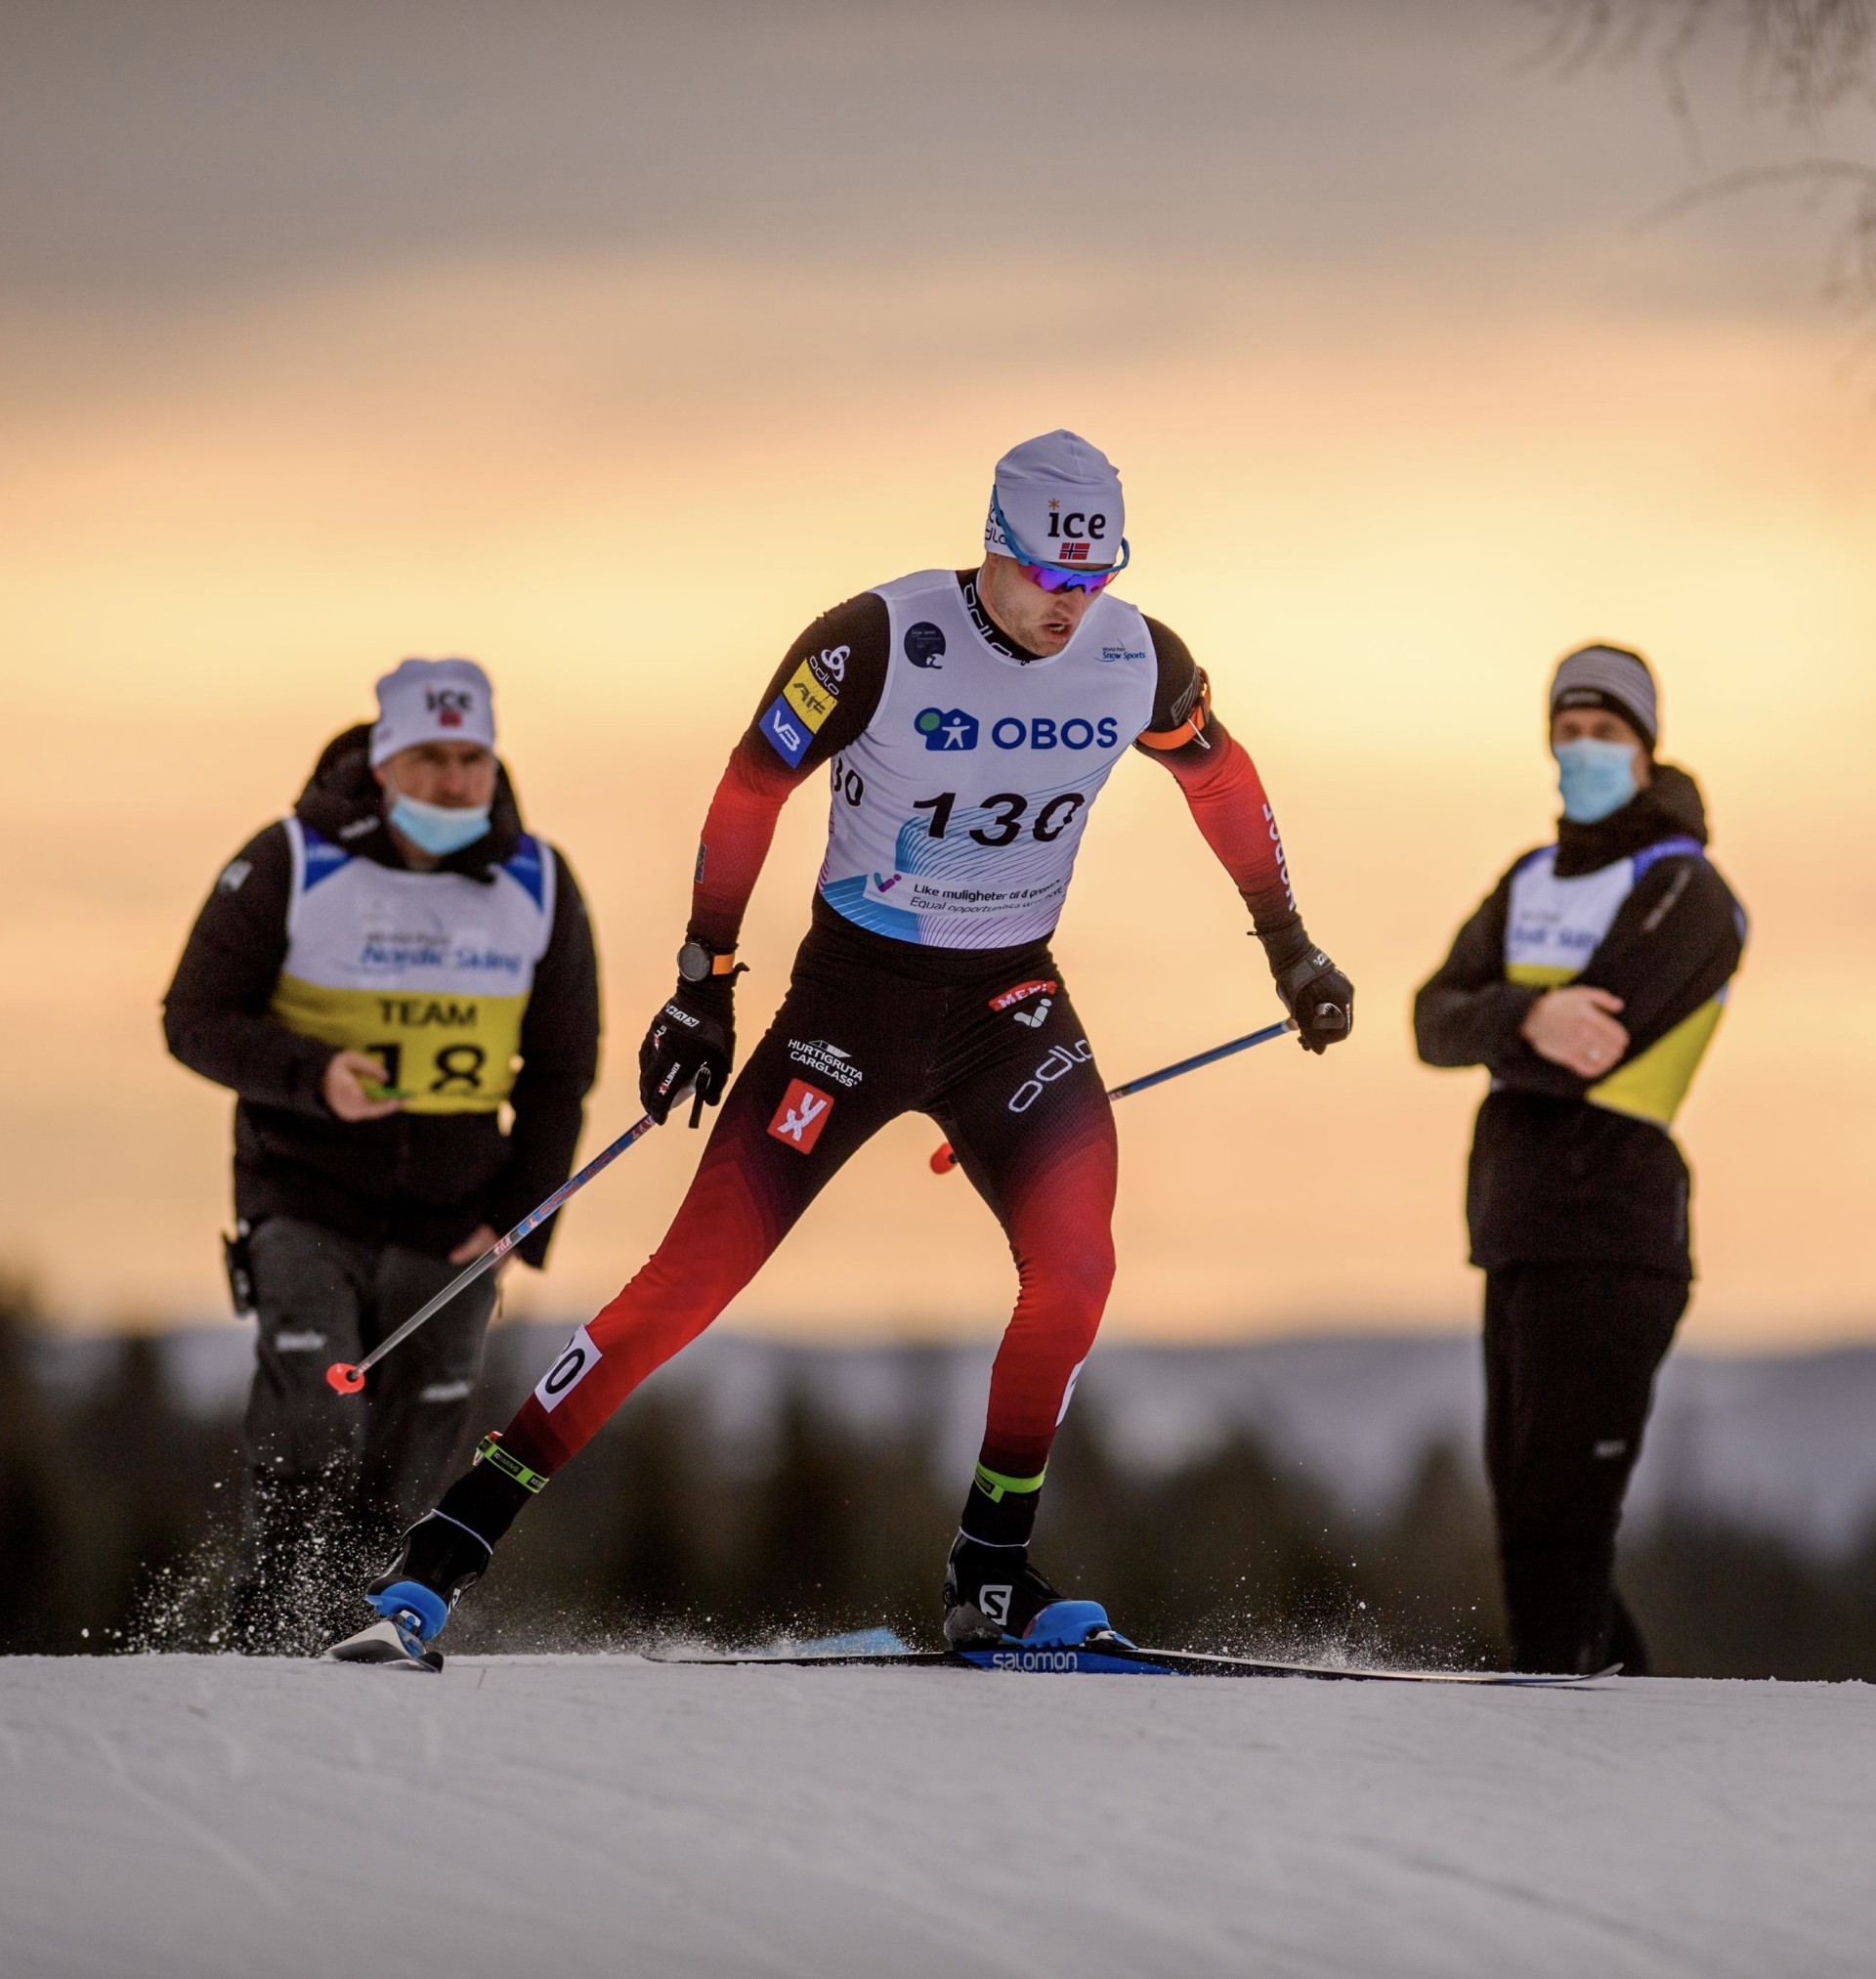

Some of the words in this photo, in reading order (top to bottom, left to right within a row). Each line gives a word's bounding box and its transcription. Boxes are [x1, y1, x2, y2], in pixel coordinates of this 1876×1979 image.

[1047, 498, 1106, 539] ice
[809, 655, 840, 696] odlo
[1123, 652, 1146, 662] Sports
[992, 717, 1119, 750] OBOS
[913, 792, 1085, 846] 130
[910, 896, 947, 911] Equal
[914, 882, 940, 896] Like
[942, 890, 1008, 903] muligheter
[377, 999, 478, 1029] TEAM
[364, 1042, 486, 1093] 18
[788, 1038, 863, 1081] HURTIGRUTA
[1008, 1039, 1093, 1113] odlo
[545, 1336, 586, 1395] 0
[992, 1652, 1078, 1671] salomon
